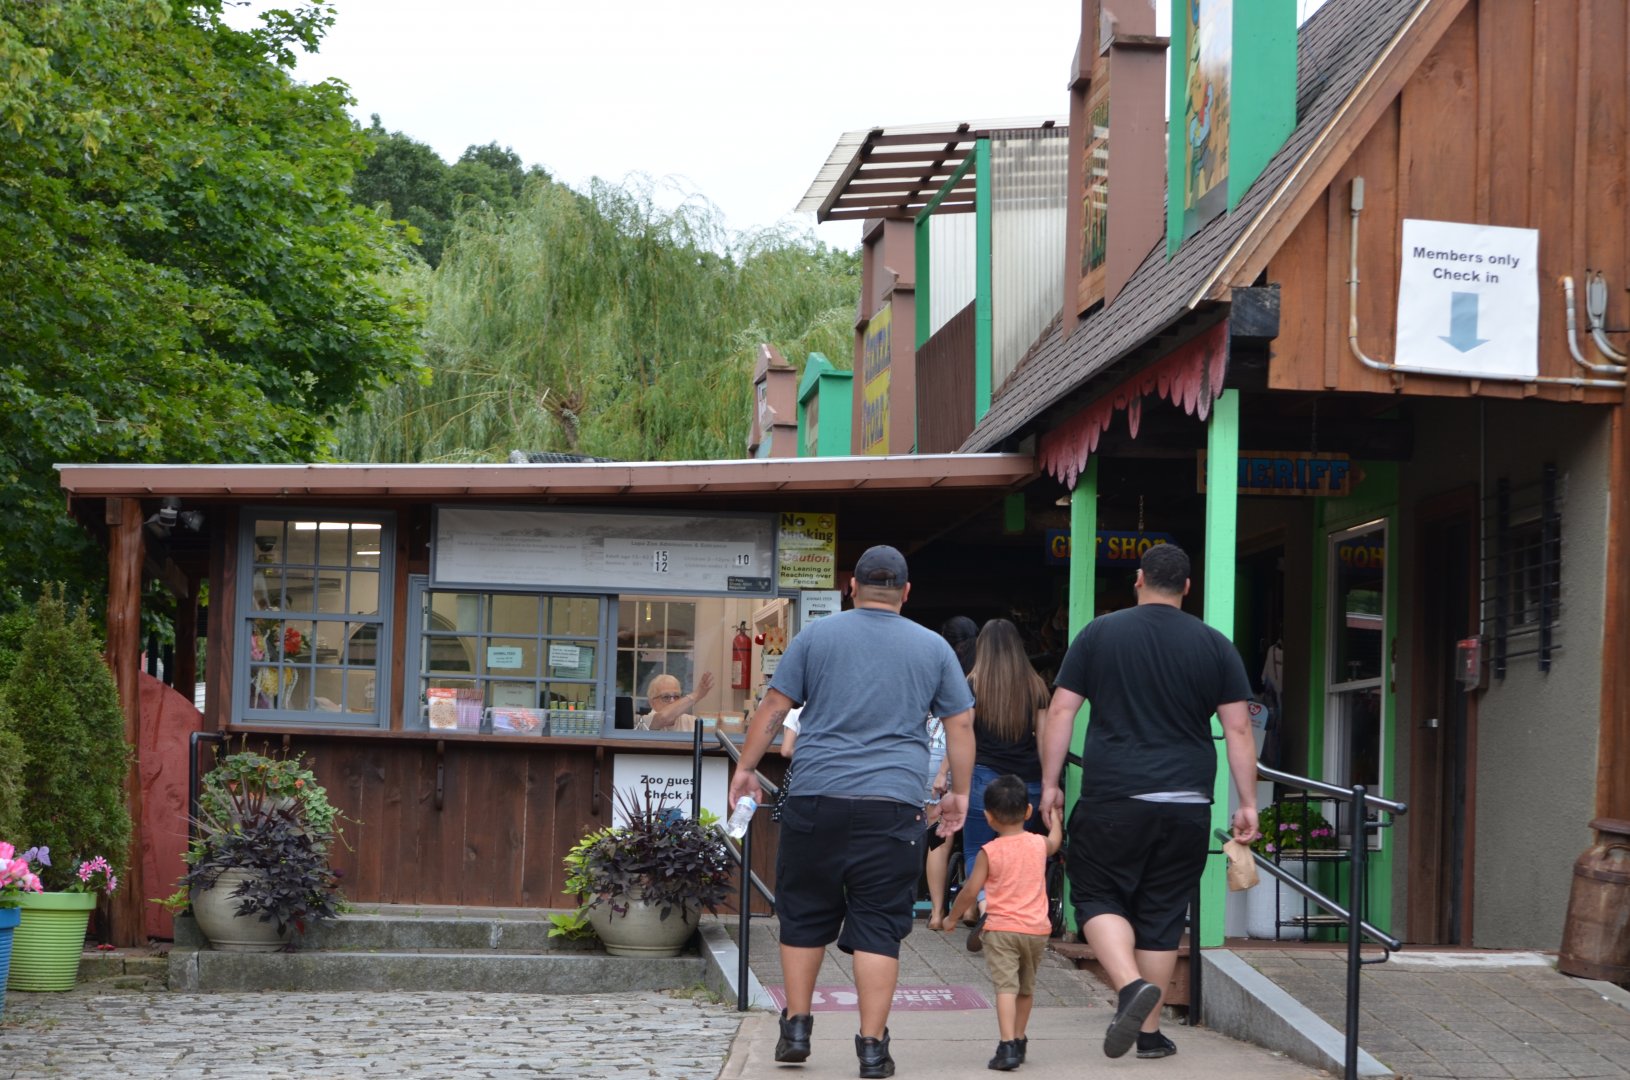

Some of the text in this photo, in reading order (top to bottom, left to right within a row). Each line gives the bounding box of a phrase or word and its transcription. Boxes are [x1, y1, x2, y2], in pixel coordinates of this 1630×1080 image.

[1412, 246, 1520, 269] Members only
[1432, 267, 1500, 284] Check in
[781, 512, 806, 527] No
[780, 528, 834, 543] Smoking
[1108, 536, 1167, 560] SHO
[655, 550, 668, 561] 15
[737, 554, 750, 565] 10
[782, 553, 831, 563] Caution
[655, 561, 668, 572] 12
[640, 774, 695, 787] Zoo gues
[644, 790, 682, 800] Check
